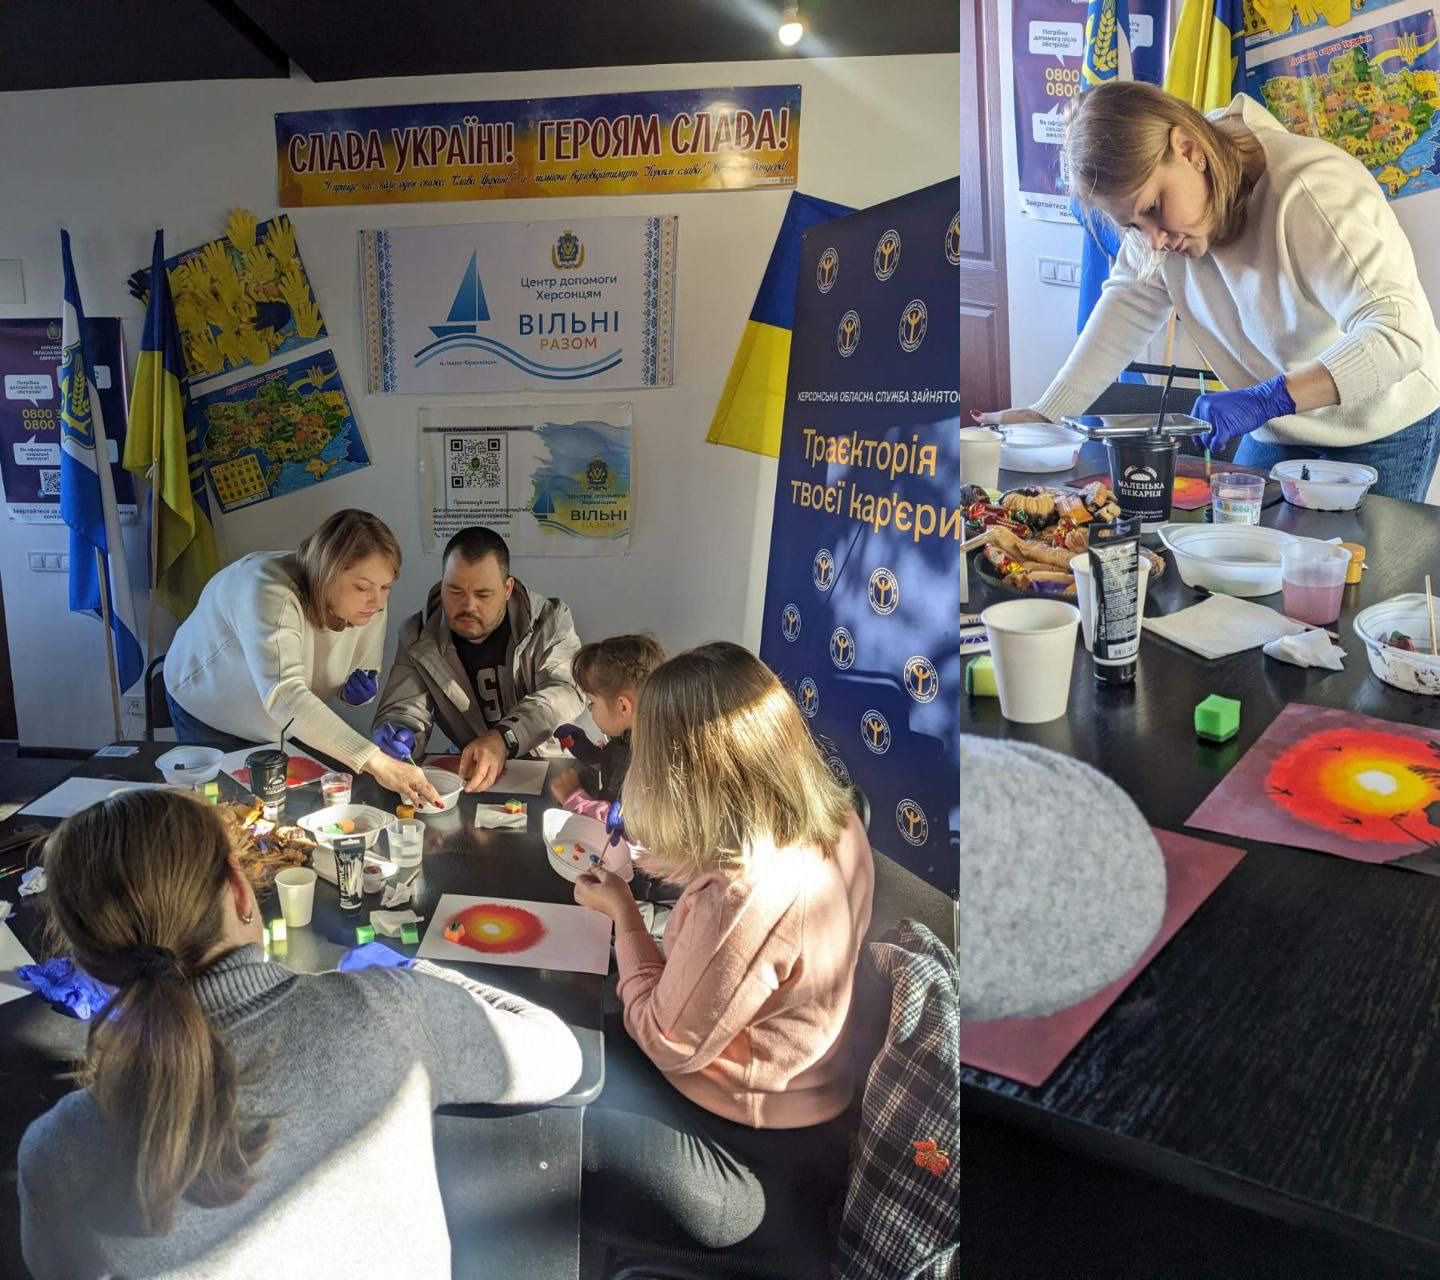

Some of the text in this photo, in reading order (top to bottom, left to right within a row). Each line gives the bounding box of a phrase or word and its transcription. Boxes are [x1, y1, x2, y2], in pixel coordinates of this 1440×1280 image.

[1045, 67, 1080, 83] 0800
[289, 107, 790, 174] СЛАВА УКРАЇНІ! ГЕРОЯМ СЛАВА!
[520, 275, 617, 289] Центр допомоги
[536, 289, 602, 301] Херсонцям
[519, 310, 619, 336] ВІЛЬНІ
[539, 336, 597, 350] РАЗОМ
[798, 391, 839, 402] ХЕРСОНСЬКА
[840, 391, 874, 403] ОБЛАСНА
[875, 390, 910, 403] СЛУЖБА
[22, 408, 53, 419] 0800
[24, 419, 55, 430] 0800
[803, 428, 938, 481] Траєкторія
[1117, 479, 1165, 490] МАЛЕНЬКА
[570, 509, 628, 521] ВІЛЬНІ
[790, 479, 960, 543] твоєї кар'єри
